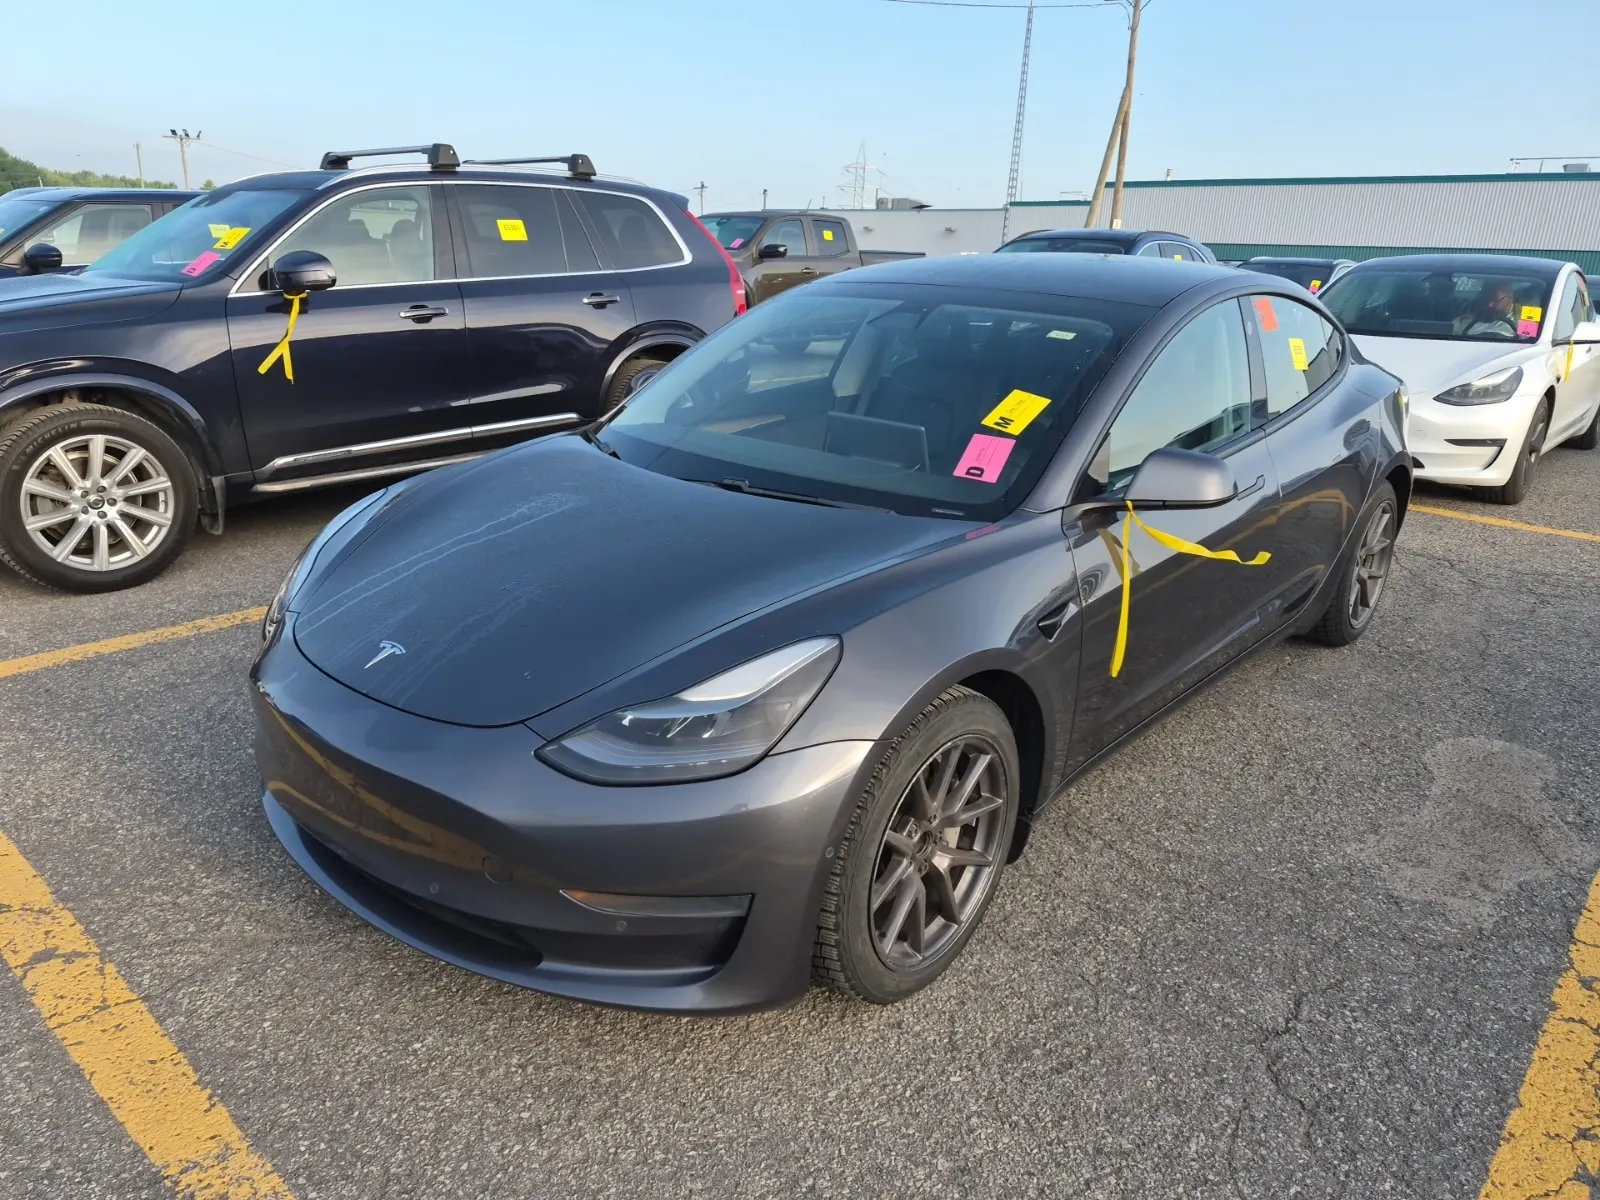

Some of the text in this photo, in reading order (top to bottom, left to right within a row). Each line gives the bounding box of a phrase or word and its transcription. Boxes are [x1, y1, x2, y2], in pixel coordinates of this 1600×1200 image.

[993, 416, 1015, 429] M
[26, 422, 78, 454] MICHELIN
[965, 466, 985, 478] D
